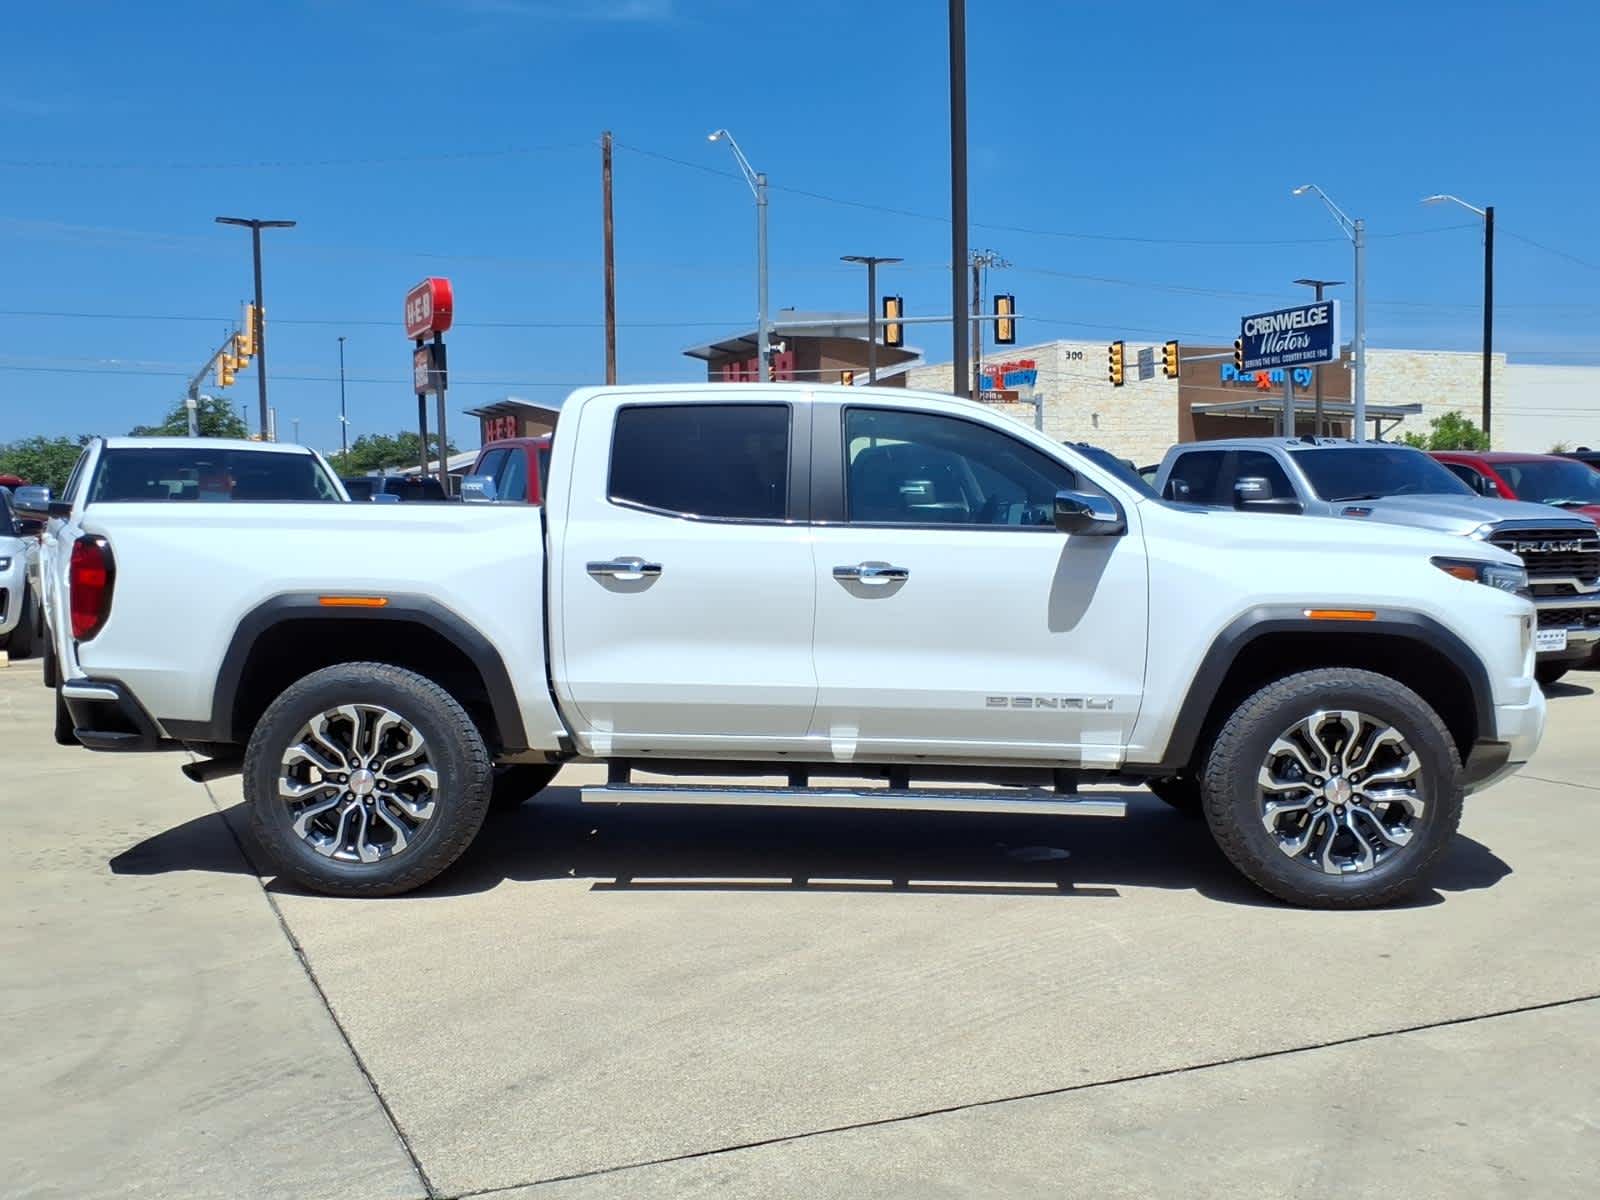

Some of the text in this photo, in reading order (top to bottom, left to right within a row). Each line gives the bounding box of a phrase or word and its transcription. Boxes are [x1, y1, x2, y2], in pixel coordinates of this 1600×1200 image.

[1244, 306, 1328, 337] CRENWELGE
[1260, 330, 1311, 355] Motors
[1065, 351, 1083, 360] 300
[1262, 357, 1271, 366] THE
[1282, 352, 1303, 363] COUNTRY
[1303, 350, 1316, 359] SINCE
[985, 695, 1113, 709] DENALI
